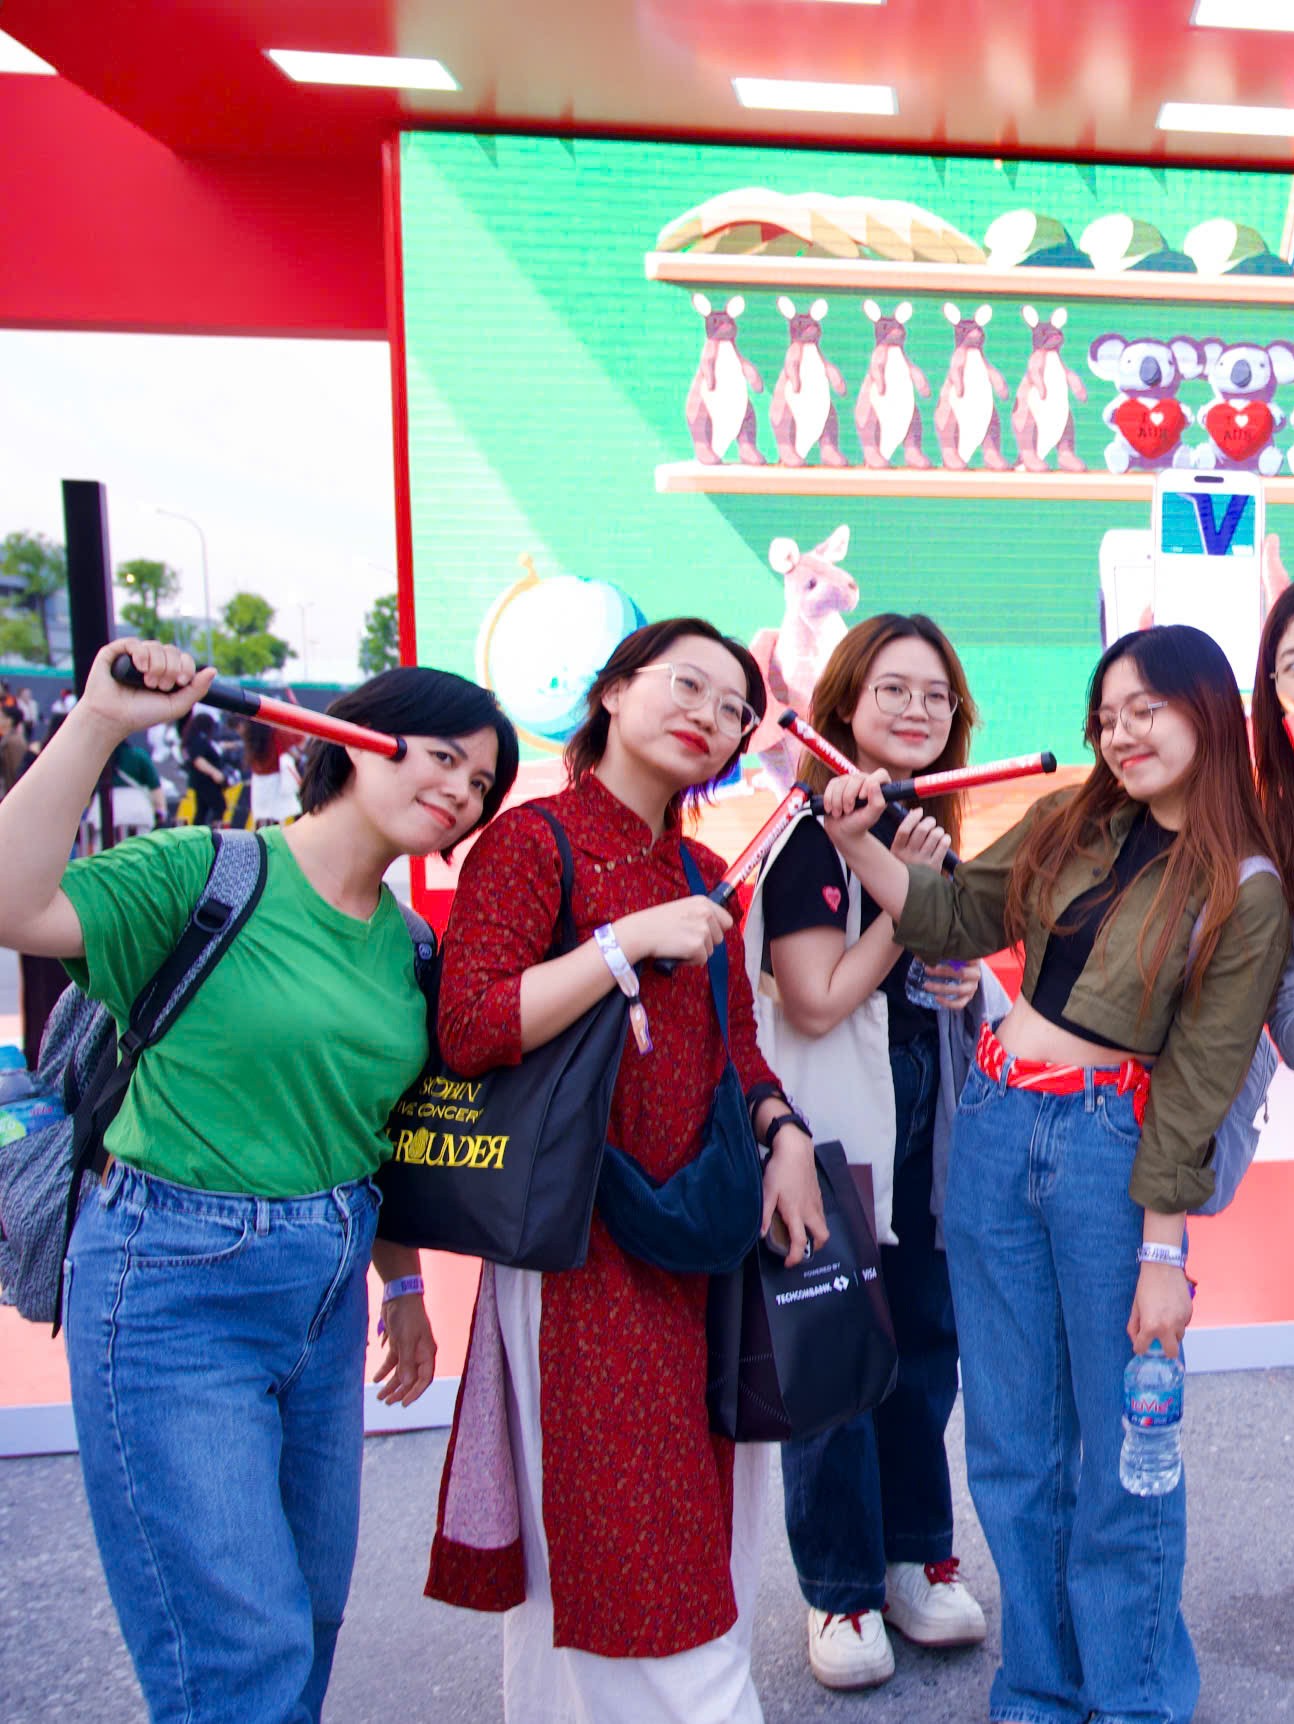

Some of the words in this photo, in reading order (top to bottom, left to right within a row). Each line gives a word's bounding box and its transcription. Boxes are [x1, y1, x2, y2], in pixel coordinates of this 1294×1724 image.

[925, 759, 1012, 784] TECHCOMBANK
[775, 1281, 833, 1306] TECHCOMBANK
[862, 1265, 878, 1282] VISA
